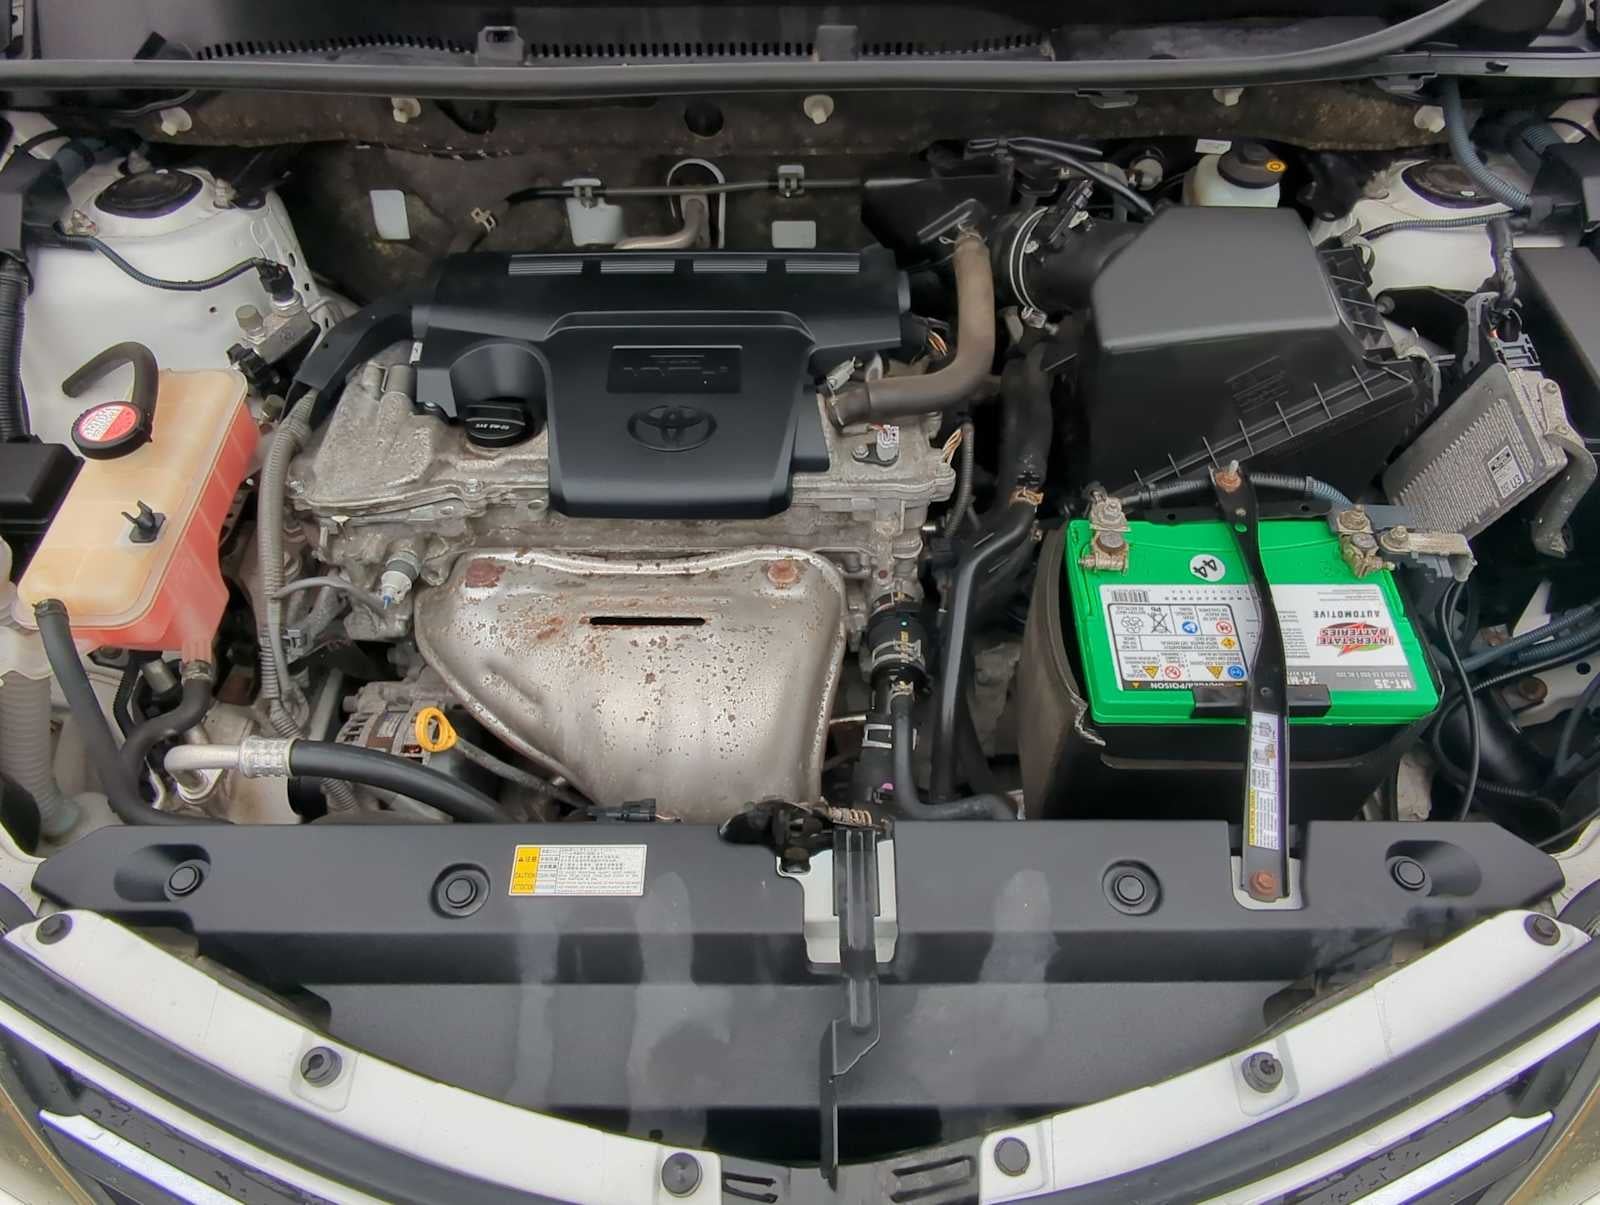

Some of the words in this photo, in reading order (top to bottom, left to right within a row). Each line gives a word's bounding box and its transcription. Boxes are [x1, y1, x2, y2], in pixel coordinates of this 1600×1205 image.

[1312, 610, 1380, 619] AUTOMOTIVE
[1320, 627, 1388, 637] BATTERIES
[1318, 636, 1393, 646] INTERSTATE
[1374, 678, 1411, 689] MT-35
